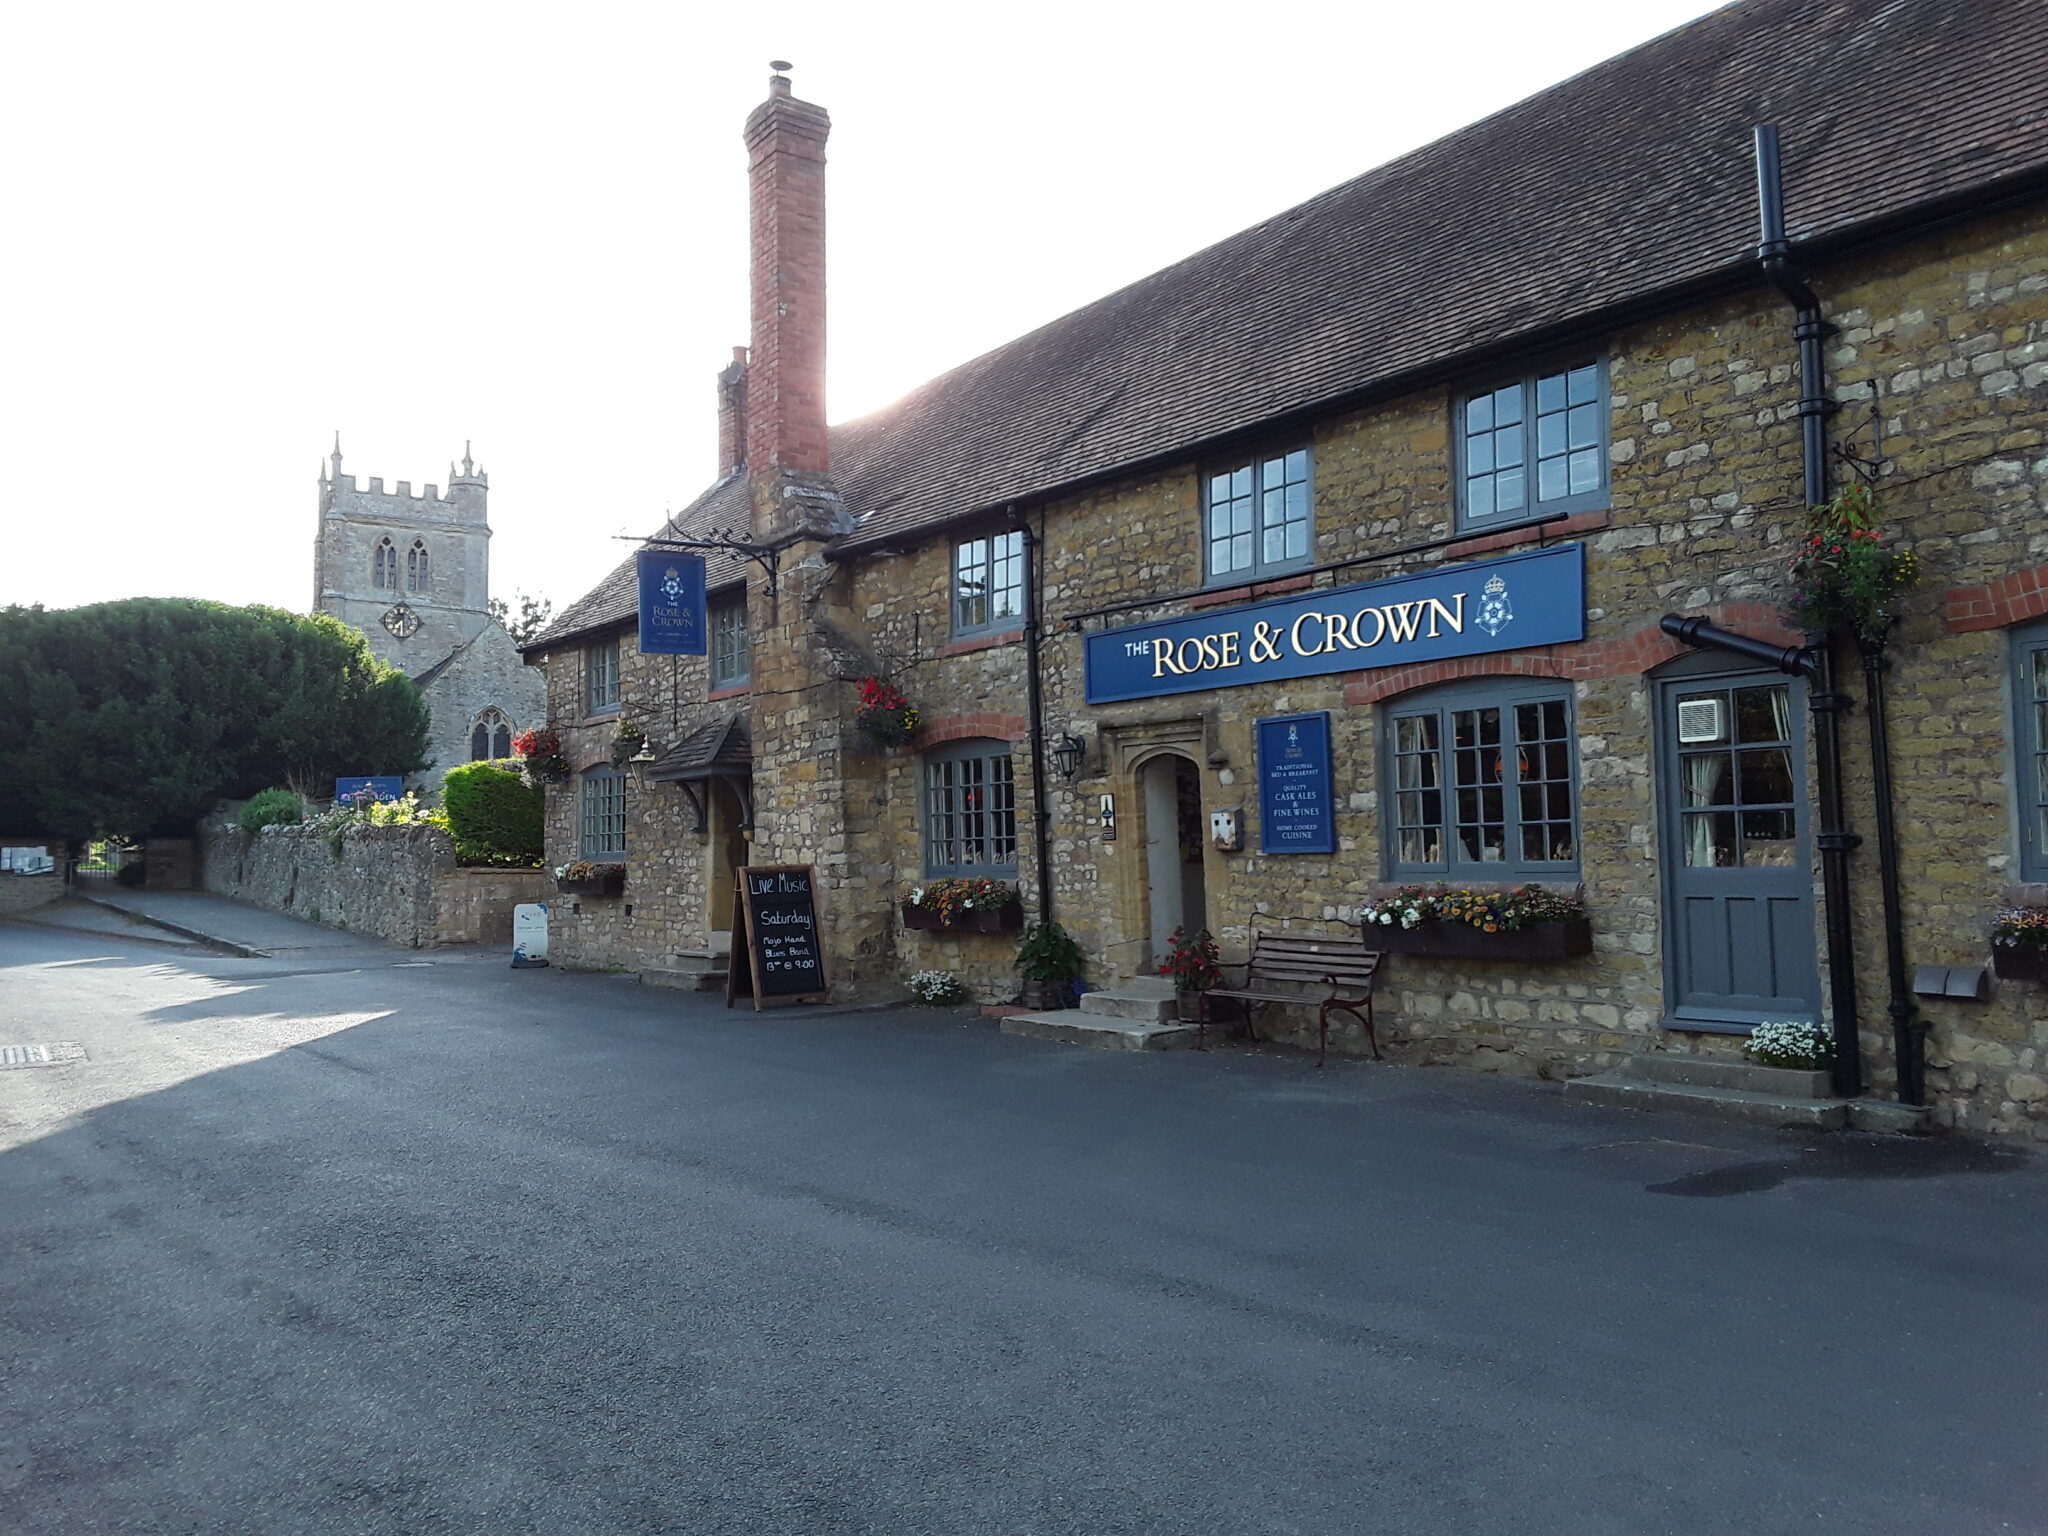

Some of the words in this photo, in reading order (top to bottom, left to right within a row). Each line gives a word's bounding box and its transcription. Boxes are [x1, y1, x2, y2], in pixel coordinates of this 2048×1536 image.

[653, 605, 680, 617] ROSE
[682, 608, 691, 618] &
[651, 615, 694, 628] CROWN
[1125, 640, 1149, 657] THE
[1152, 631, 1242, 678] ROSE
[1249, 620, 1285, 664] &
[1291, 592, 1468, 657] CROWN
[1276, 763, 1313, 771] TRADITIONAL
[1283, 784, 1307, 792] QUALITY
[1275, 792, 1296, 801] CASK
[1297, 791, 1317, 800] ALES
[1273, 809, 1293, 817] FINE
[1293, 807, 1320, 816] WINES
[1281, 831, 1313, 840] CUISINE
[748, 874, 774, 895] Live
[778, 872, 809, 893] Music
[760, 909, 811, 930] Saturday
[763, 936, 782, 948] Mojo
[784, 934, 807, 944] Hand
[765, 948, 786, 958] Blues
[789, 946, 810, 956] Band
[794, 959, 815, 969] 9:00
